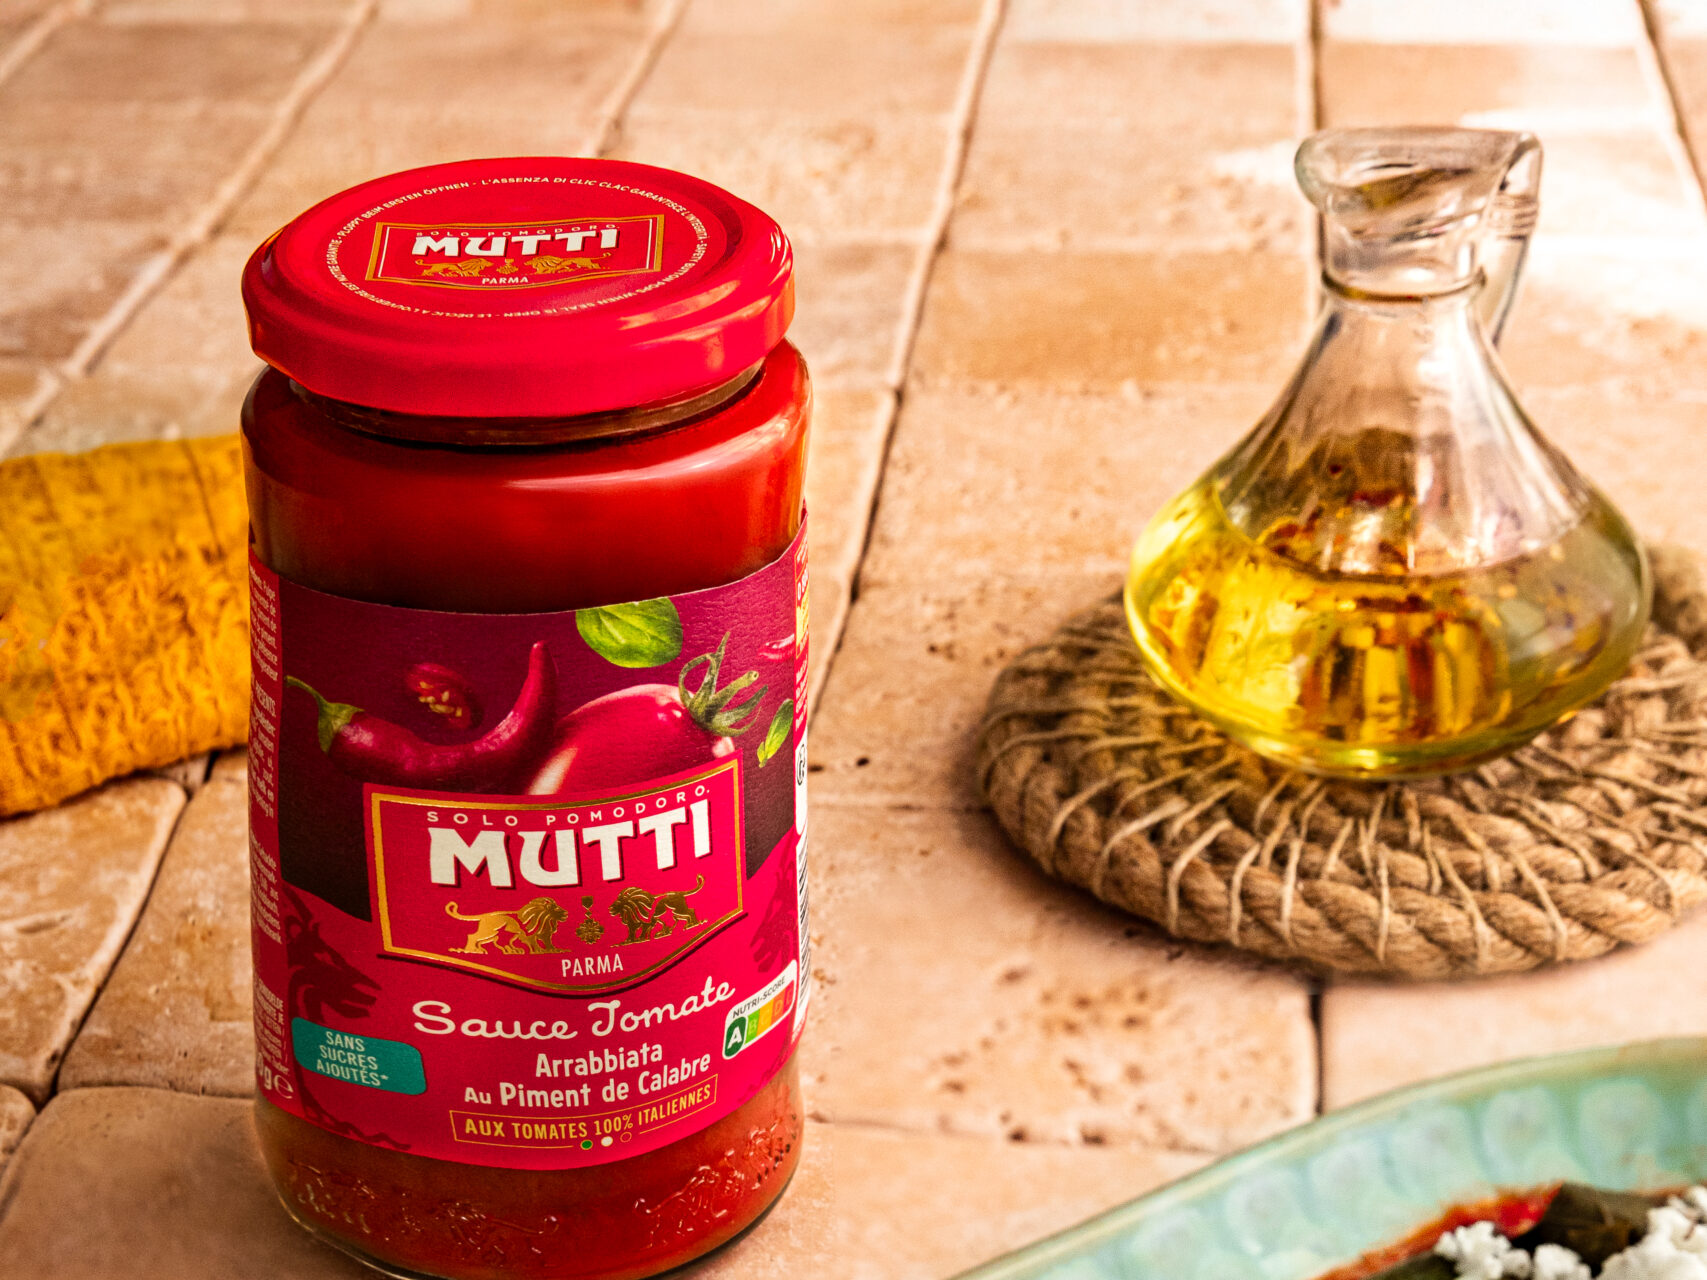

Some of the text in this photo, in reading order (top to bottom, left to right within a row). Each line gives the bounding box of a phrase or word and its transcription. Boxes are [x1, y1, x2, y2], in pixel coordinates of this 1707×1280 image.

[361, 206, 384, 218] BEIM
[382, 192, 422, 208] ERSTEN
[423, 181, 469, 195] ÖFFNEN
[481, 177, 550, 185] L'ASSENZA
[569, 178, 597, 186] CLIC
[599, 181, 630, 191] CLAC
[630, 188, 687, 212] GARANTISCE
[412, 228, 618, 257] MUTTI
[481, 276, 529, 285] PARMA
[426, 810, 519, 827] SOLO
[428, 798, 713, 888] MUTTI
[561, 953, 624, 978] PARMA
[412, 1000, 579, 1040] Sauce
[587, 975, 736, 1037] Tomate
[732, 975, 786, 1019] NUTRI-SCORE
[325, 1030, 366, 1052] SANS
[726, 1025, 743, 1050] A
[318, 1044, 379, 1071] SUCRES
[535, 1042, 663, 1078] Arrabbiata
[464, 1053, 711, 1108] Au Piment de Calabre
[464, 1083, 711, 1140] AUX TOMATES 100% ITALIENNES
